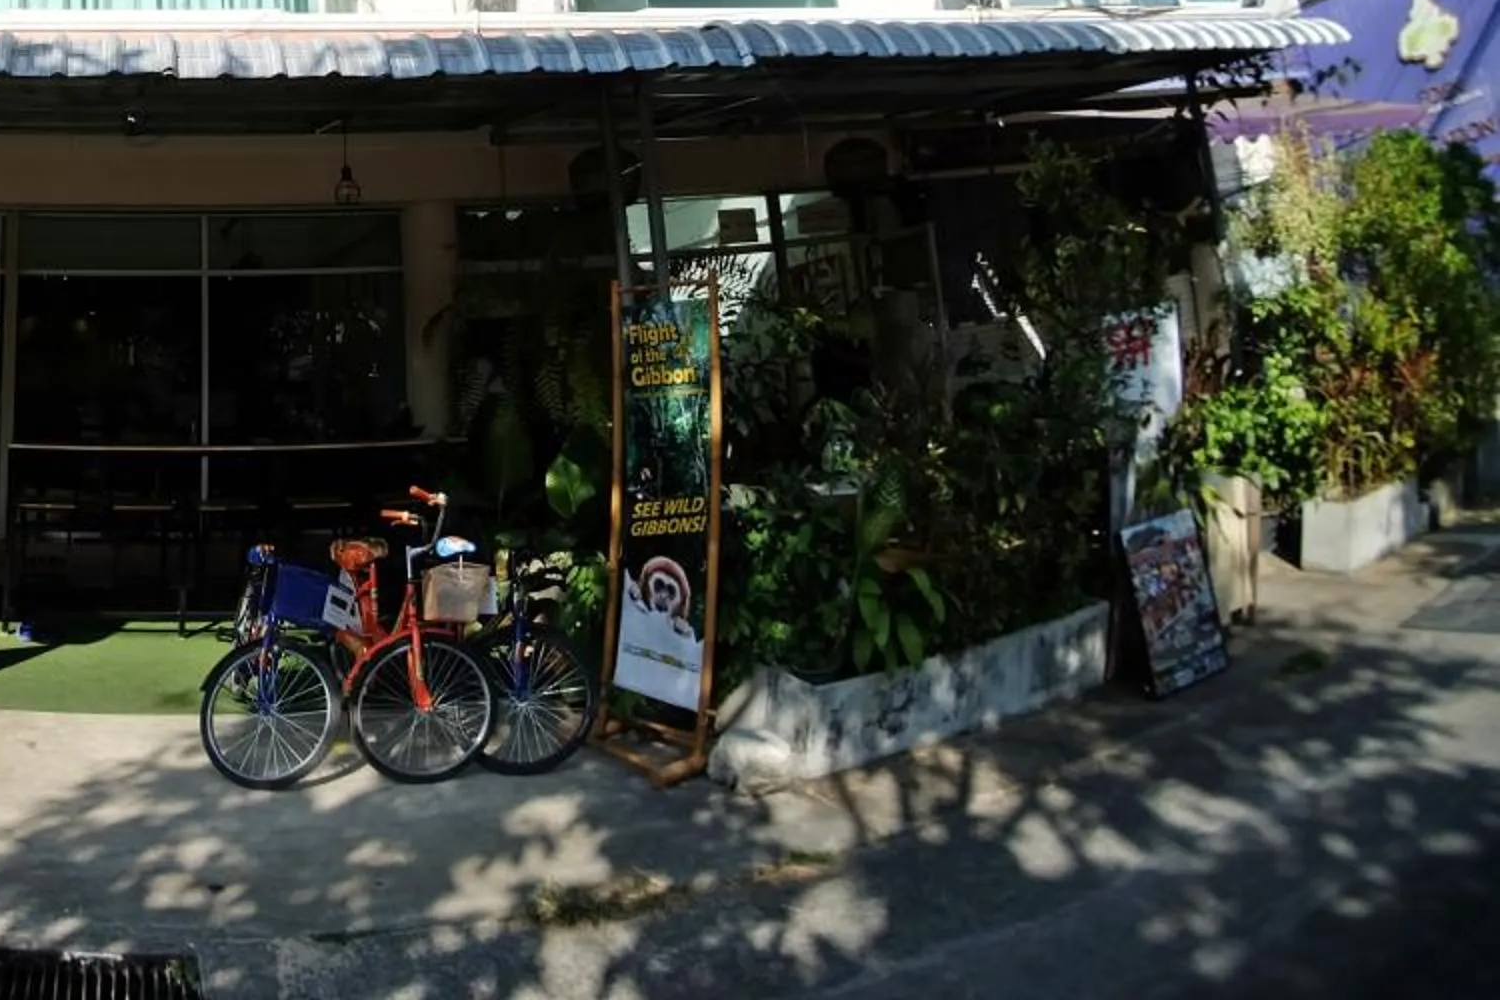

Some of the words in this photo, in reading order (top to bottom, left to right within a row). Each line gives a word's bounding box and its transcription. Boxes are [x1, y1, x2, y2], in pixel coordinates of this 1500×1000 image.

[629, 321, 678, 346] Flight
[632, 364, 696, 387] Gibbon
[632, 501, 662, 518] SEE
[664, 497, 705, 515] WILD
[631, 515, 707, 537] GIBBONS!
